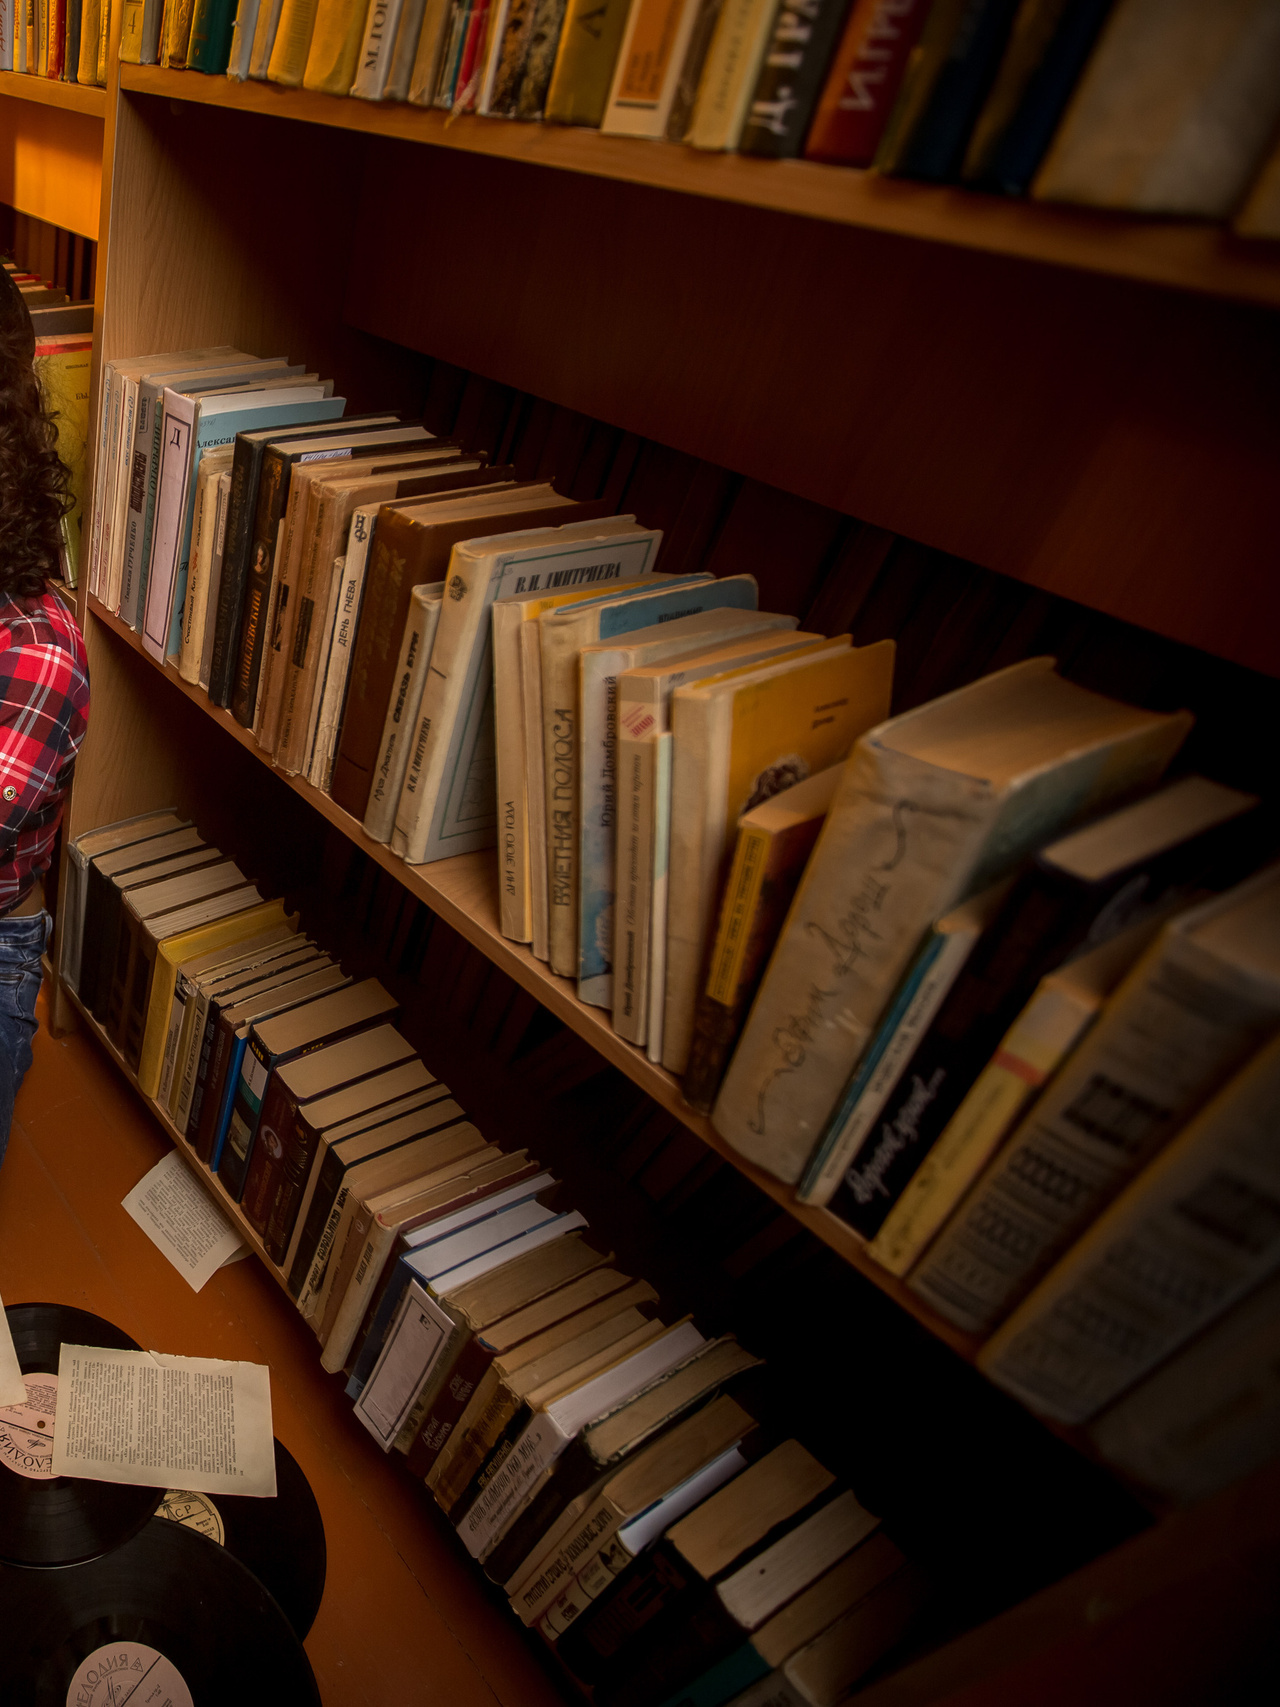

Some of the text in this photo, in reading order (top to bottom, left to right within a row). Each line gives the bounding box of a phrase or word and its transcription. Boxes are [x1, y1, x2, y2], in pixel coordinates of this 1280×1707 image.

[146, 422, 164, 491] ОТКРЫТИЕ
[169, 427, 182, 449] Д
[125, 520, 139, 568] ГУРЧЕНКО
[237, 588, 264, 690] ДАНИЛЕВСКИЙ
[336, 578, 359, 646] ДЕНЬ ГНЕВА
[548, 706, 578, 801] ПОЛОСА
[598, 674, 622, 827] Юрий Домбровский
[503, 800, 517, 896] ДНИ ЭТОГО ГОДА
